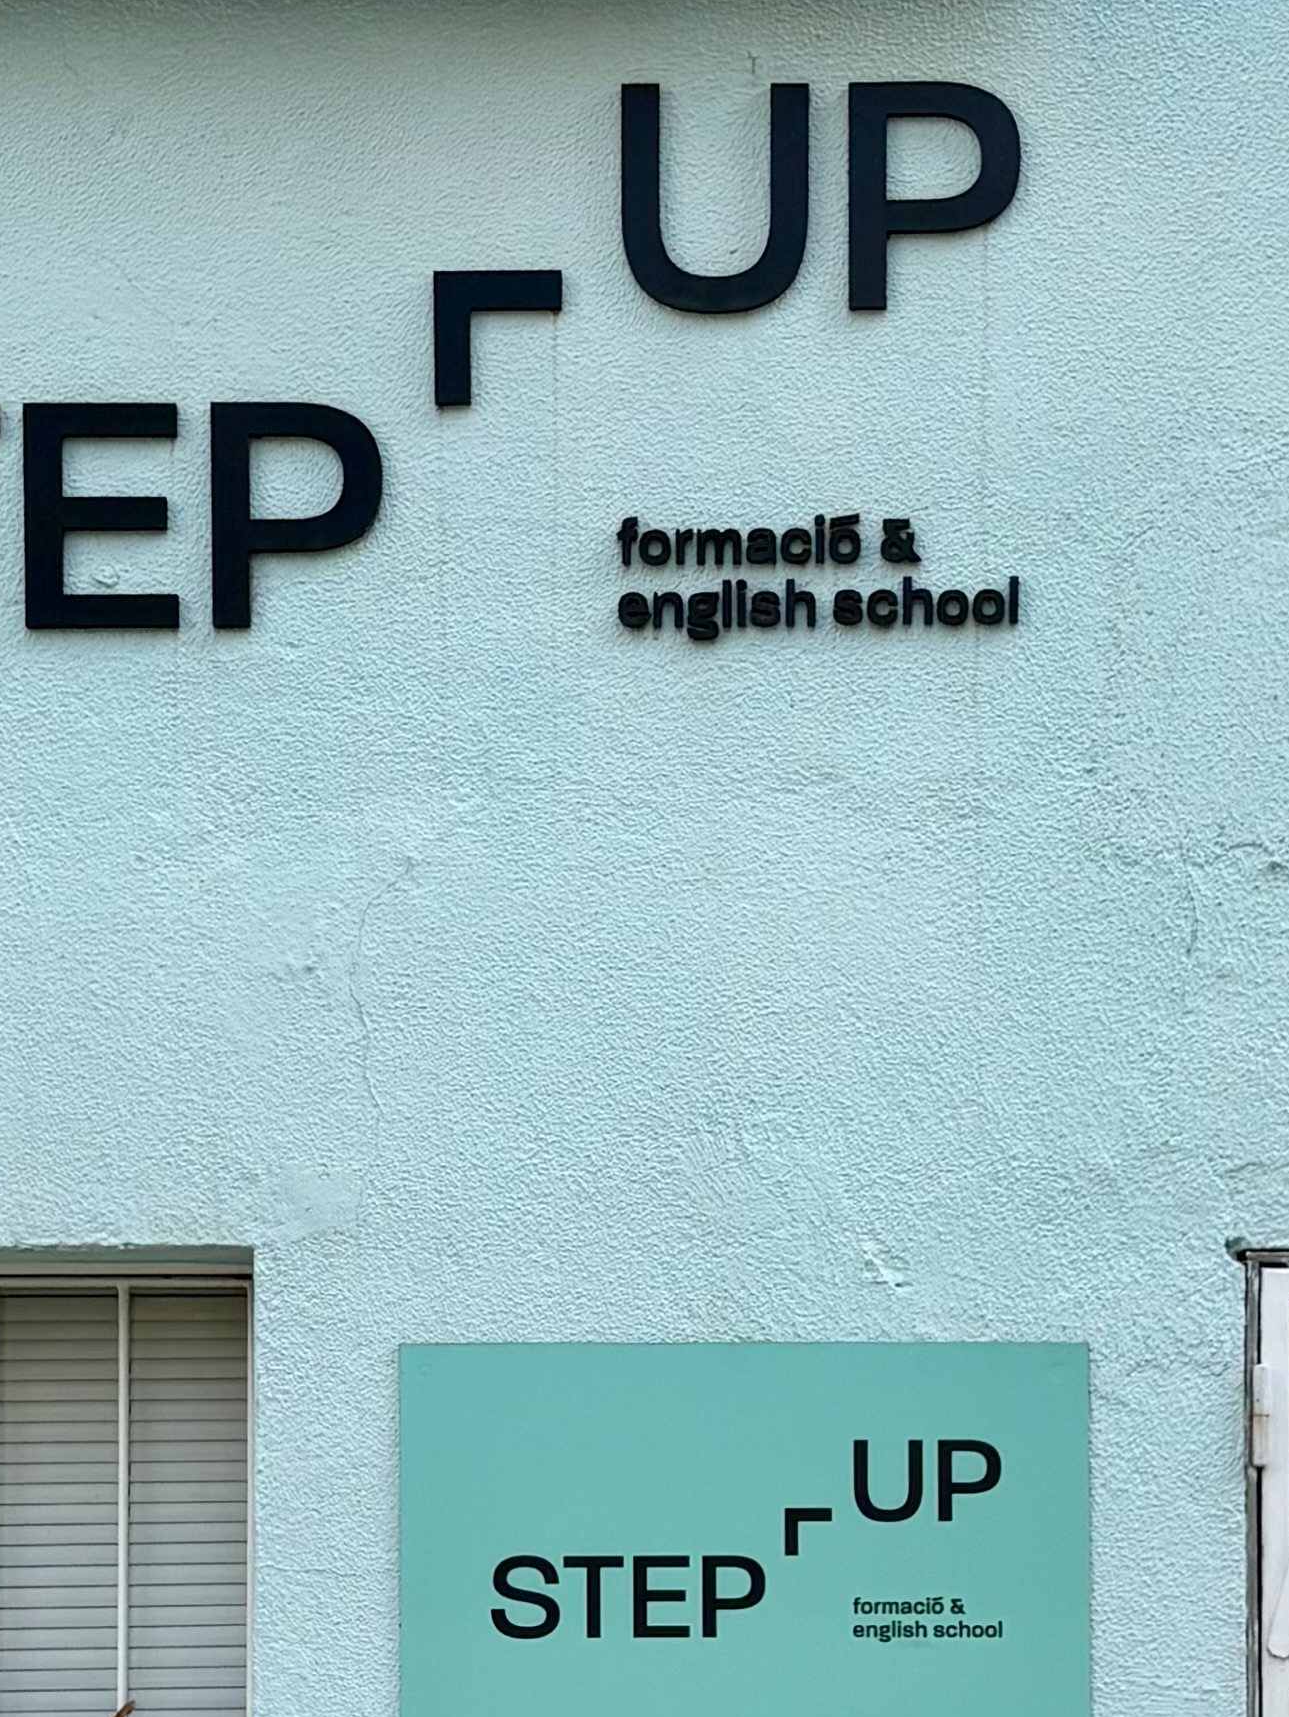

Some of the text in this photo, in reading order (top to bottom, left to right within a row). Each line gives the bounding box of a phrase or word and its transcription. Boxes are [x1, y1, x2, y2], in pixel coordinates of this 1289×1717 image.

[621, 81, 1021, 315] UP
[617, 513, 922, 567] formació &
[618, 575, 1020, 641] english school
[854, 1440, 1001, 1522] UP
[491, 1555, 765, 1639] STEP
[853, 1597, 965, 1615] formació &
[853, 1620, 1003, 1643] english school
